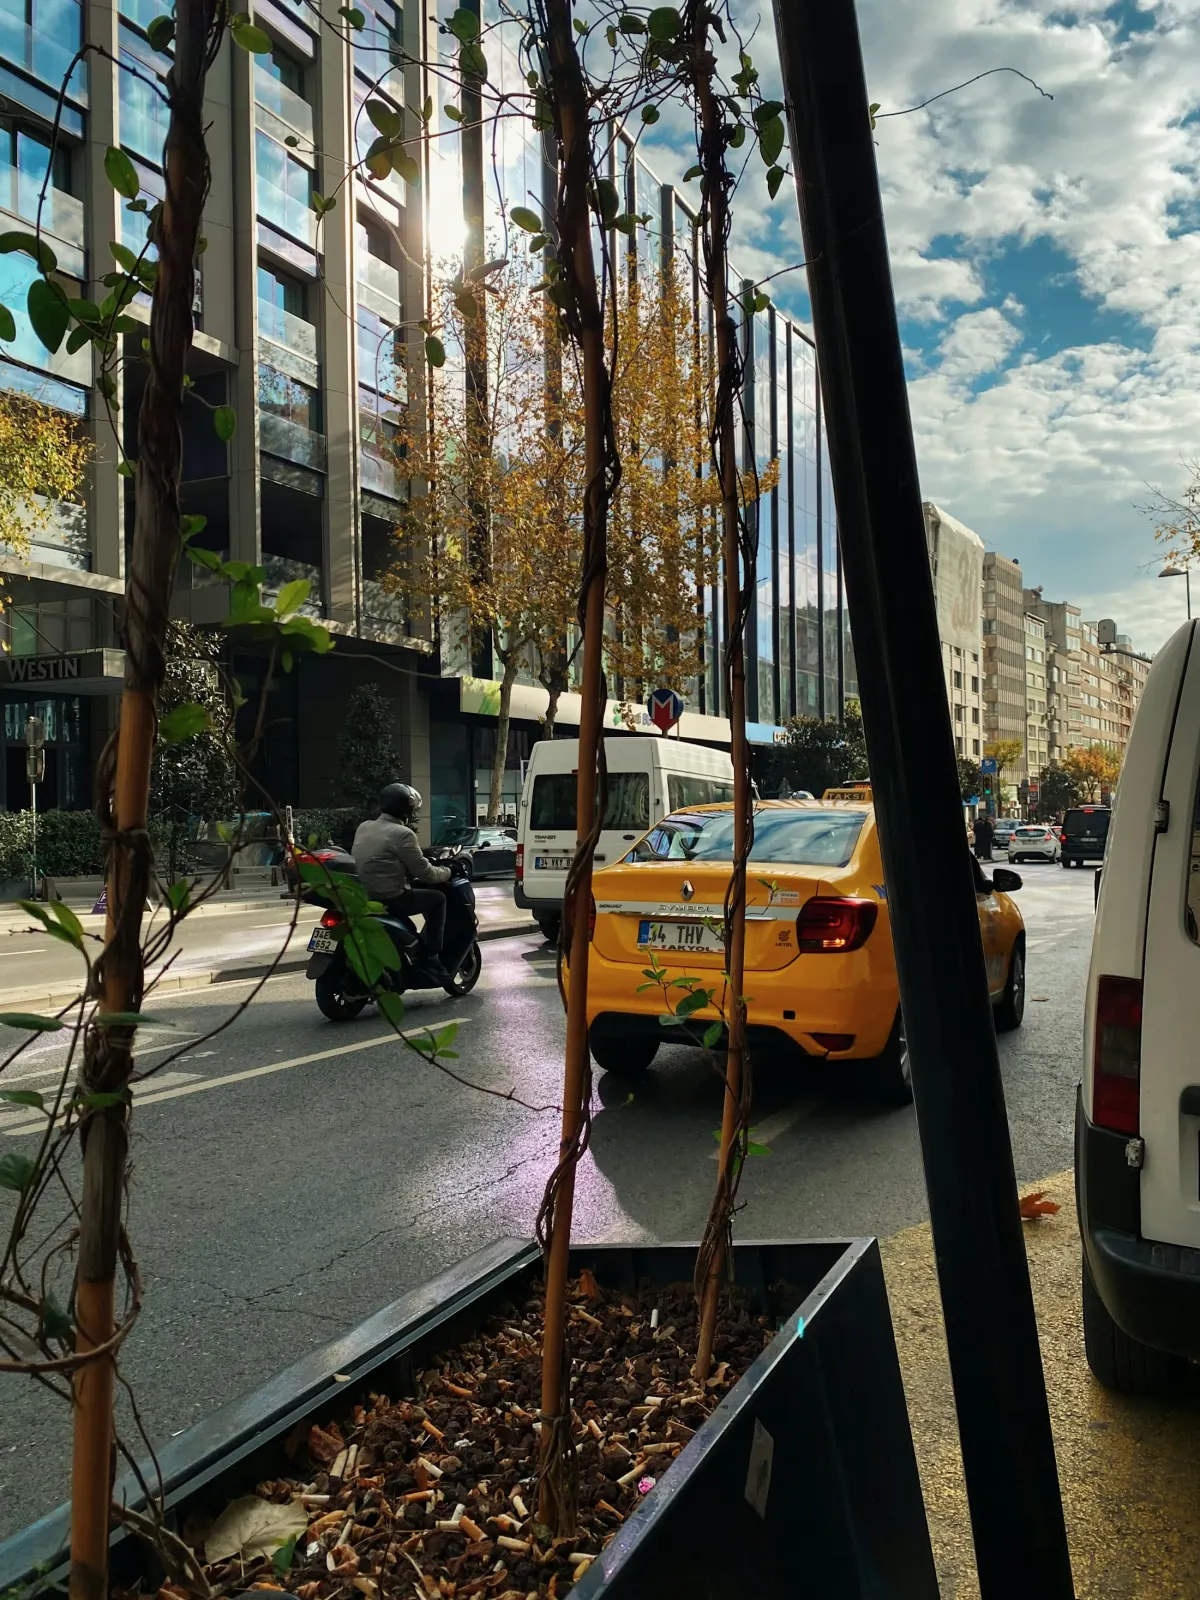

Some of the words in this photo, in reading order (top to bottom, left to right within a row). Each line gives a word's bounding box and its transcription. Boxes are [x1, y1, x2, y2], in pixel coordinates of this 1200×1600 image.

[5, 658, 79, 682] WESTIN
[658, 905, 714, 913] SYMBOL
[676, 925, 704, 945] THV
[315, 940, 331, 950] 652
[667, 944, 713, 953] AKYOL
